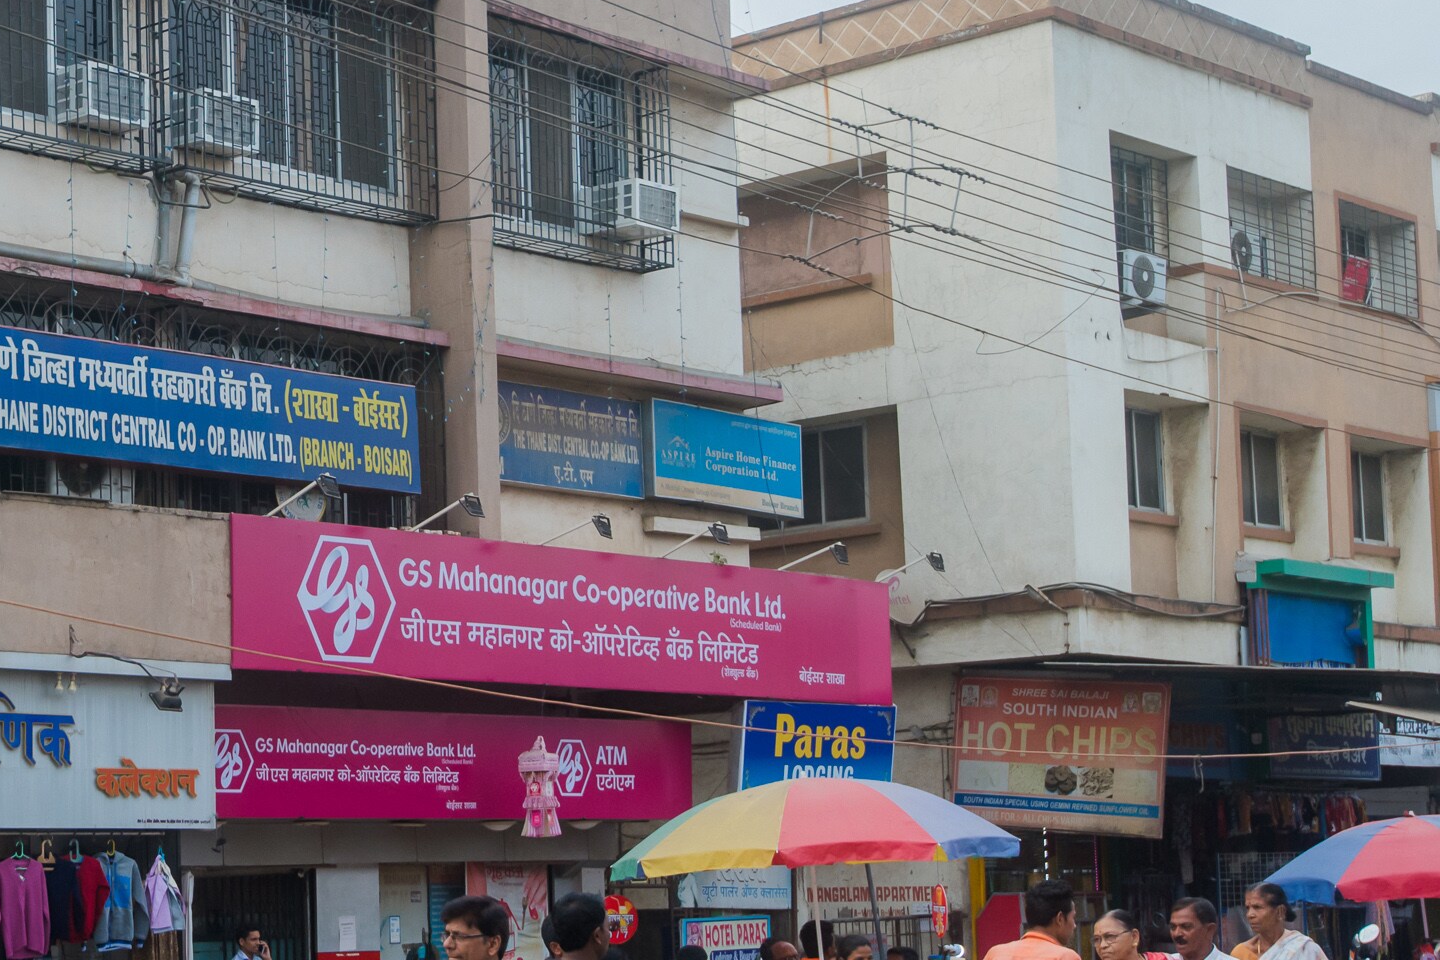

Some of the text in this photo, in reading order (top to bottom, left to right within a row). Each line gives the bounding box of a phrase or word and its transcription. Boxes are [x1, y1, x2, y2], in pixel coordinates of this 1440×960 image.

[22, 340, 76, 387] जिल्हा
[80, 355, 148, 400] मध्यवर्ती
[151, 366, 216, 408] सहकारी
[219, 369, 247, 411] बँक
[43, 404, 107, 440] DISTRICT
[111, 412, 175, 450] CENTRAL
[177, 422, 197, 453] CO
[208, 427, 228, 457] OP.
[231, 430, 267, 462] BANK
[269, 433, 297, 465] LTD.
[300, 437, 355, 473] (BRANCH
[364, 446, 413, 485] BOISAR)
[513, 429, 526, 450] THE
[526, 430, 547, 453] THANE
[563, 435, 590, 458] CENTRAL
[705, 446, 797, 472] Aspire Home Finance
[705, 459, 760, 478] Corporation
[398, 557, 786, 620] GS Mahanagar Co-operative Bank Ltd.
[729, 617, 782, 633] (Scheduled Bank)
[467, 621, 544, 651] महानगर
[665, 626, 693, 661] बँक
[698, 630, 759, 665] लिमिटेड
[826, 671, 846, 685] शाखा
[1012, 687, 1110, 700] SHREE SAI BALAJI
[1002, 702, 1118, 720] SOUTH INDIAN
[255, 737, 476, 759] GS Mahanagar Co-operative Bank Ltd.
[774, 713, 866, 760] Paras
[961, 719, 1036, 757] HOT
[1046, 725, 1158, 765] CHIPS
[596, 745, 628, 766] ATM
[95, 757, 201, 799] कलेक्शन
[292, 767, 335, 782] महानगर
[422, 765, 459, 784] लिमिटेड
[596, 768, 635, 791] एटीएम
[963, 795, 1150, 815] SOUTH INDIAN SPECIAL USING GEMINI REFINED SUNFLOWER OIL
[705, 922, 767, 947] HOTEL PARAS
